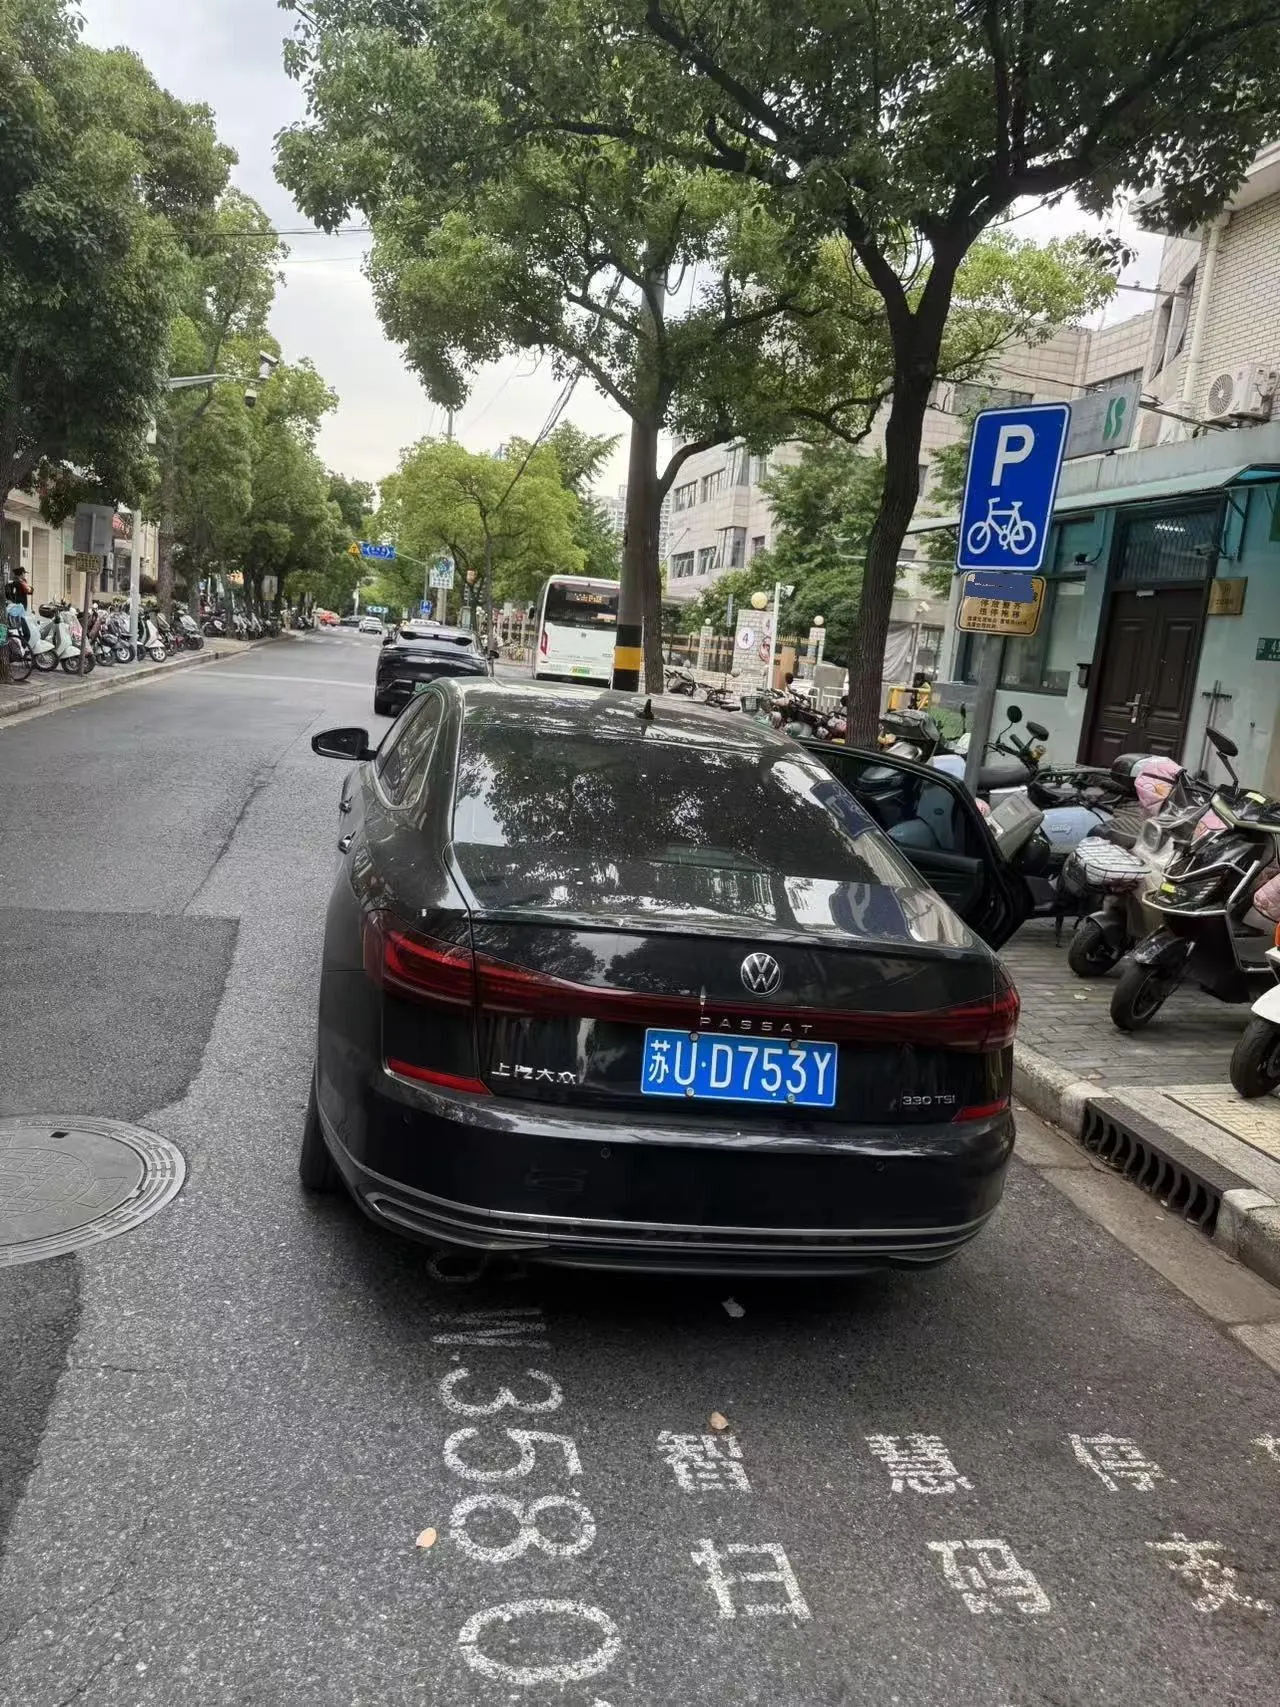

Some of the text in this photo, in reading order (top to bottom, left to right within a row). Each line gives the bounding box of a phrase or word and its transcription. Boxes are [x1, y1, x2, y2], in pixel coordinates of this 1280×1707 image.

[991, 424, 1035, 486] P
[699, 1016, 814, 1034] PASSAT
[491, 1062, 577, 1085] 上汽大众
[901, 1095, 956, 1106] 330 TSI
